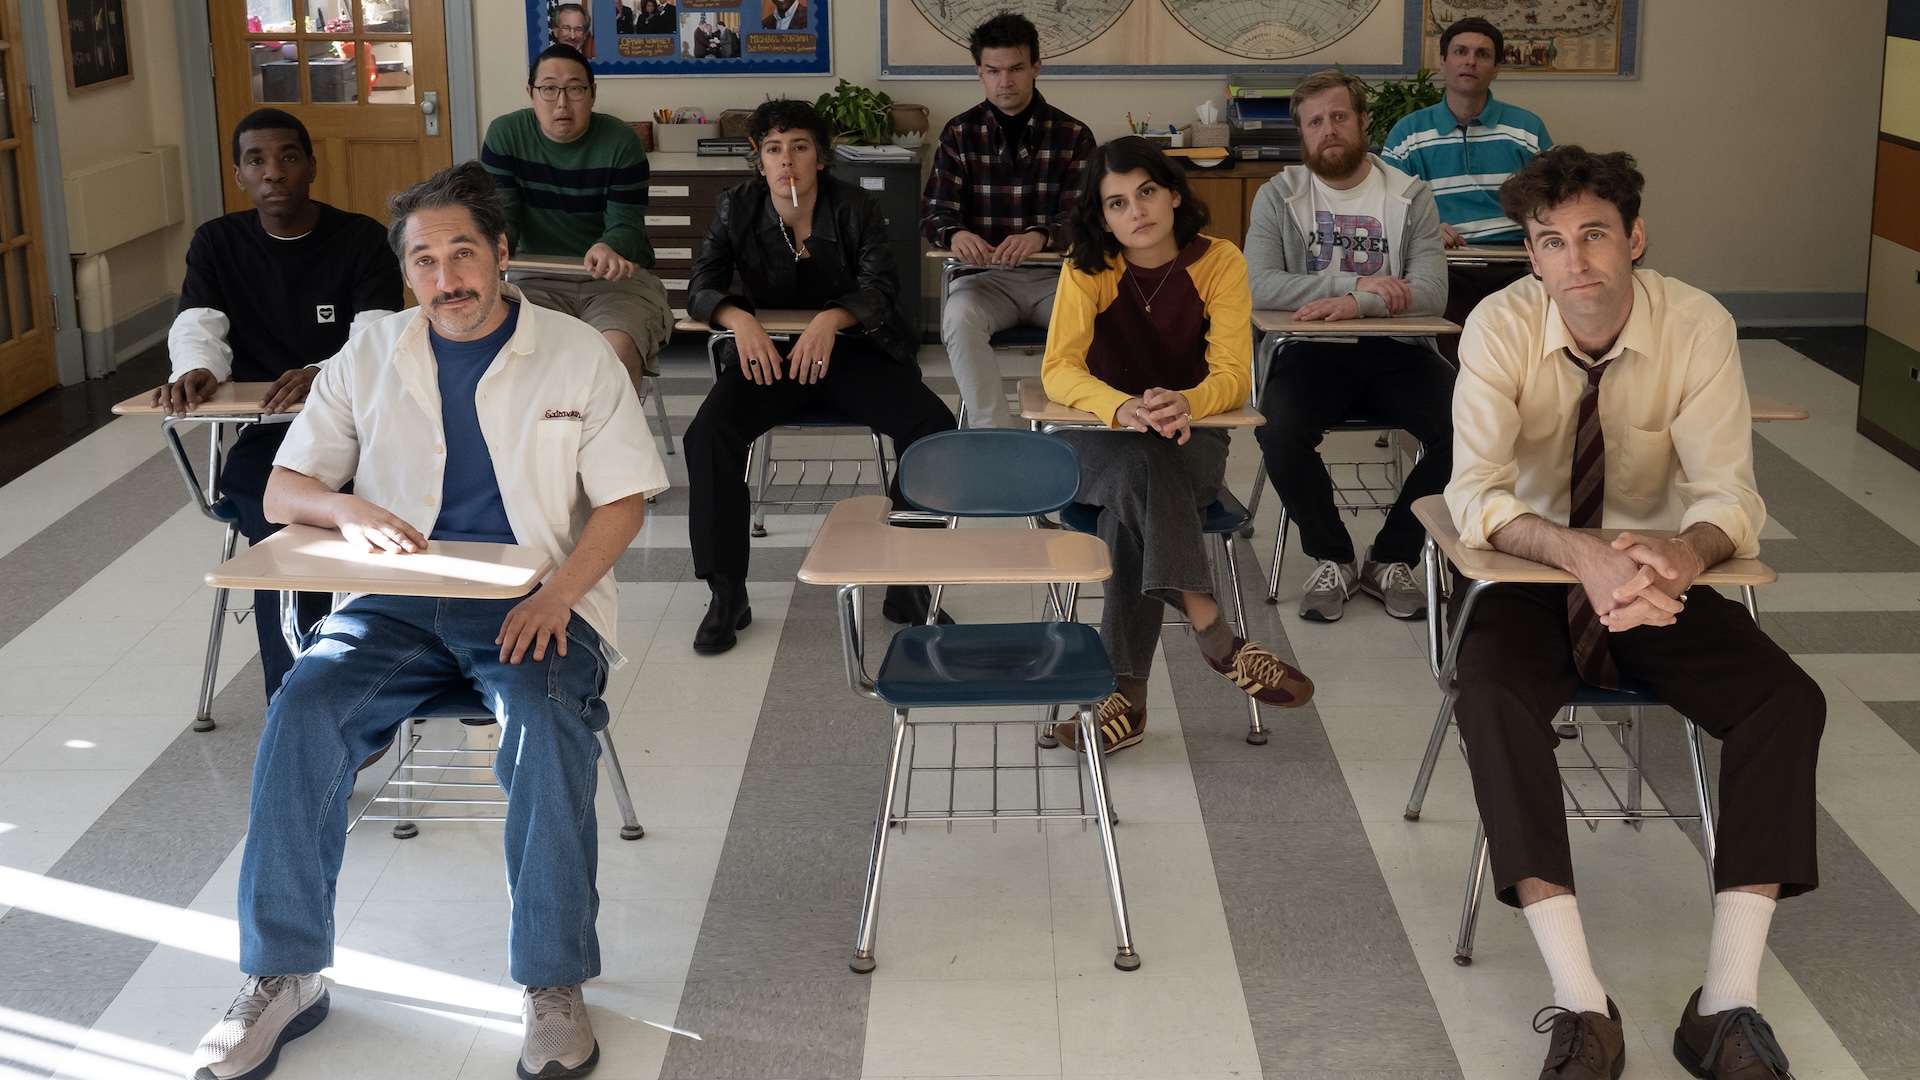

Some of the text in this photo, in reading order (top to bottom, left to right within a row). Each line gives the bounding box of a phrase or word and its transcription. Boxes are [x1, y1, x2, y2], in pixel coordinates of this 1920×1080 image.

[621, 37, 644, 46] OPRAH
[750, 35, 780, 43] MICHAEL
[782, 34, 809, 43] JORDAN
